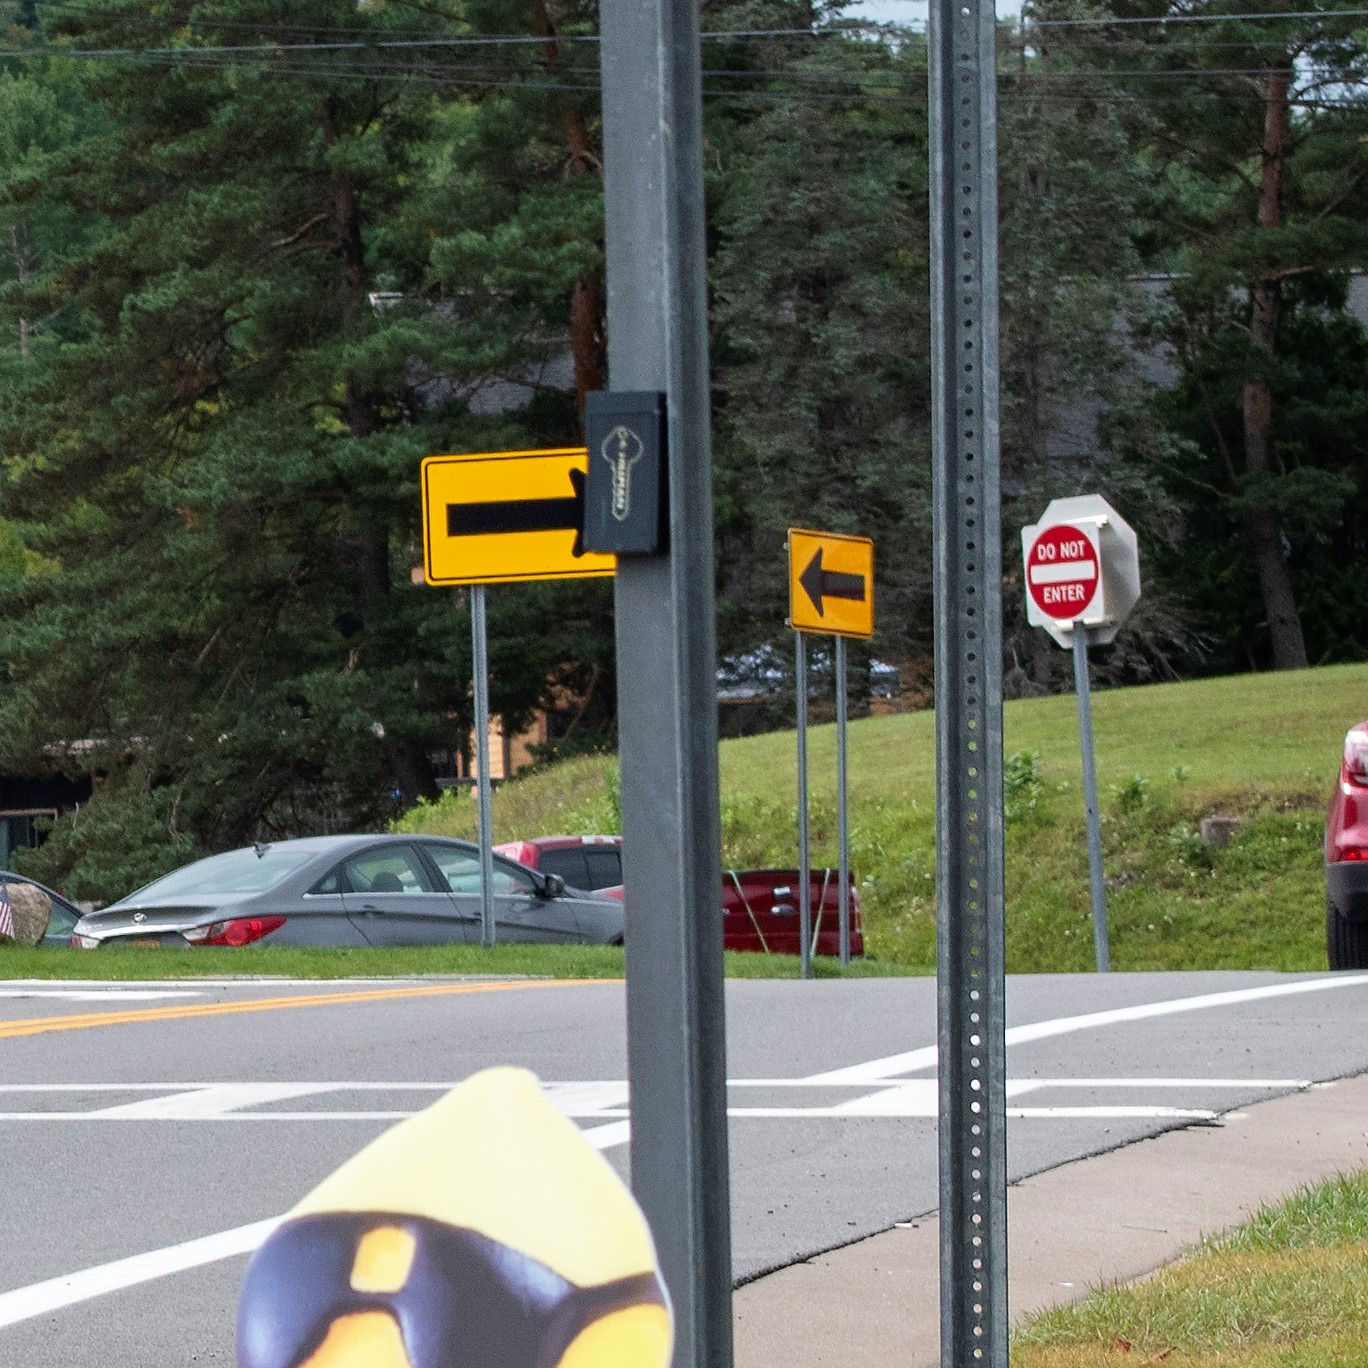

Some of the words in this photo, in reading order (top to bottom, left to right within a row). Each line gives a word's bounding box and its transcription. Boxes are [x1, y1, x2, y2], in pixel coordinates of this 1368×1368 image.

[1037, 543, 1056, 560] DO
[1060, 540, 1085, 559] NOT
[1043, 584, 1085, 604] ENTER
